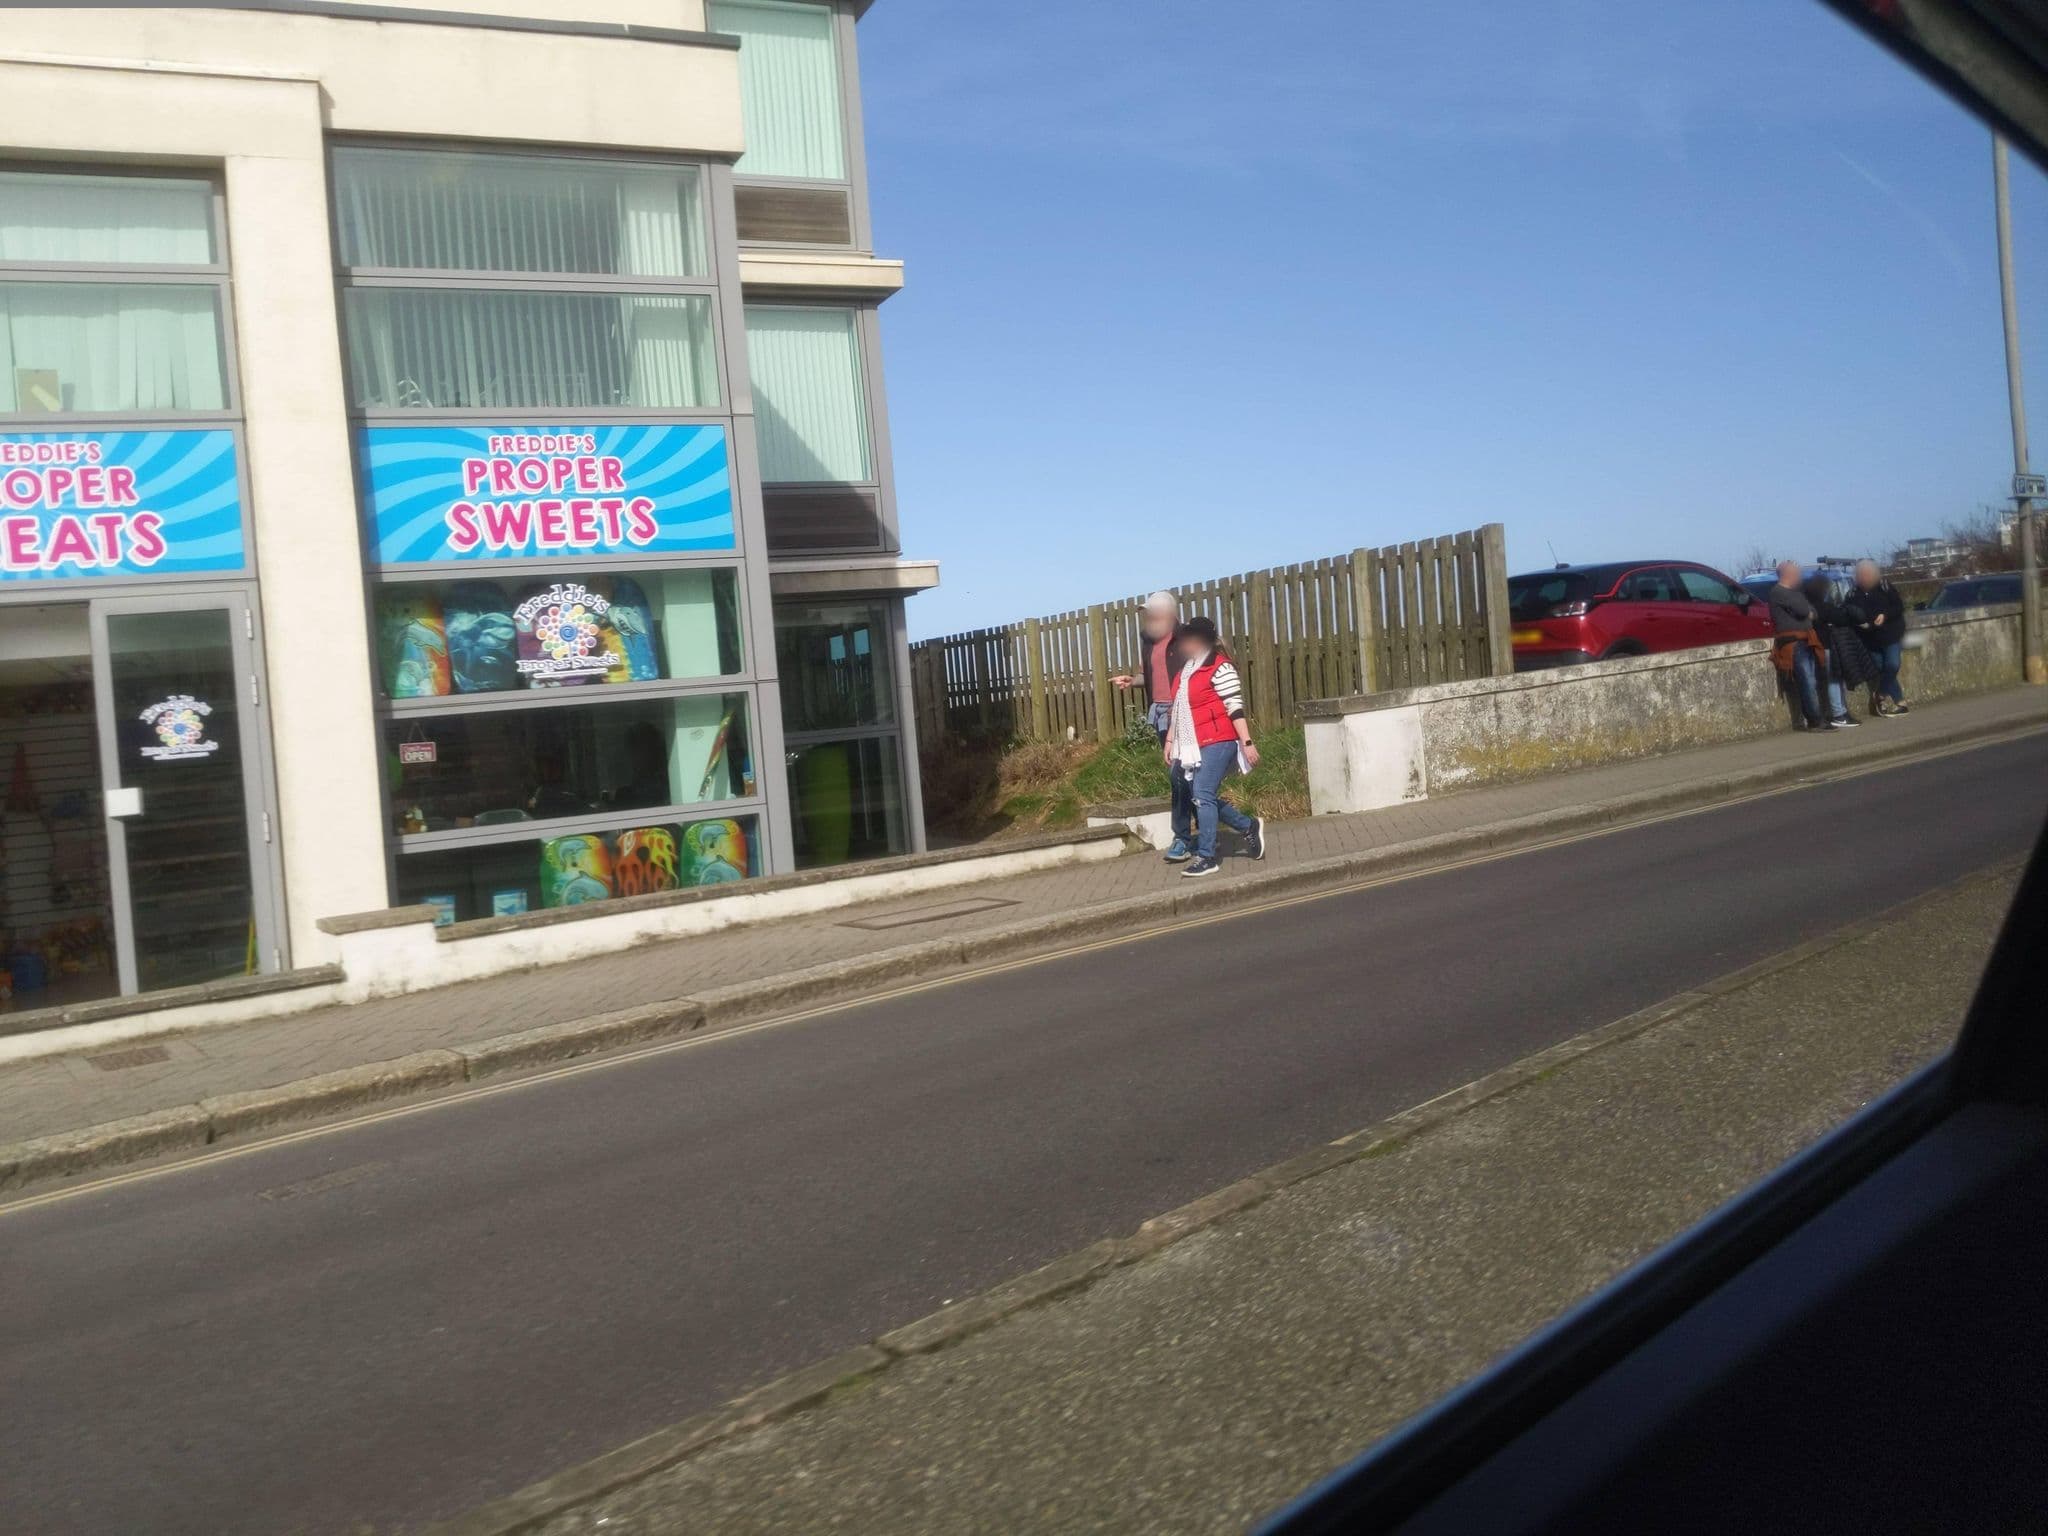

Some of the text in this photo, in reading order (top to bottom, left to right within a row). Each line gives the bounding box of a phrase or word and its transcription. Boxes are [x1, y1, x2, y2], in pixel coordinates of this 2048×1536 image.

[490, 434, 596, 454] FREDDIE'S
[0, 467, 138, 506] OPER
[465, 457, 625, 493] PROPER
[446, 498, 657, 549] SWEETS
[404, 751, 432, 761] OPEN
